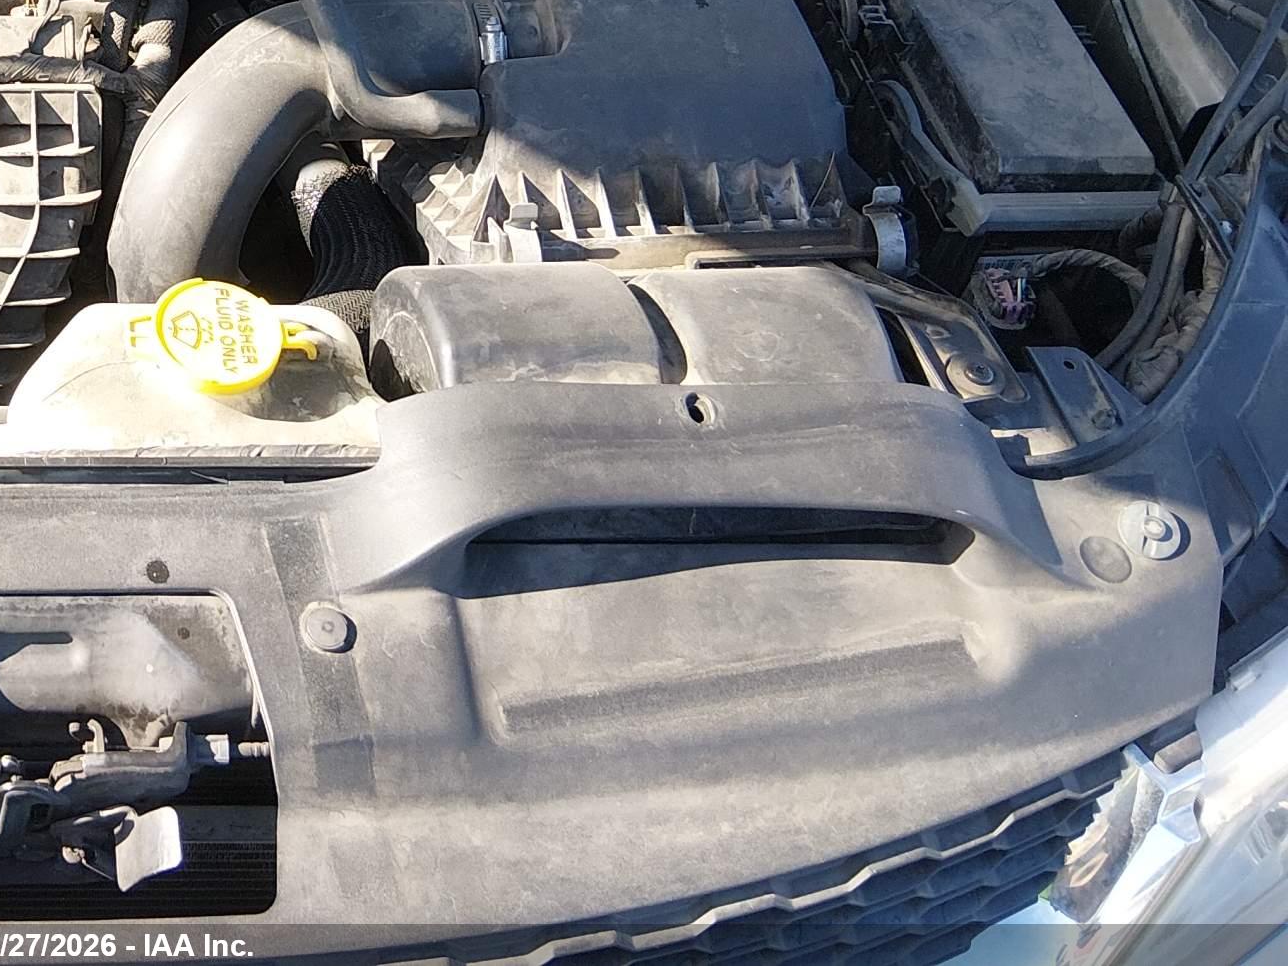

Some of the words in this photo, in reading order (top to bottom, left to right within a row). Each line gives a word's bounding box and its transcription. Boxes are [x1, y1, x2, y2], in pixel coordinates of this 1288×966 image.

[215, 288, 233, 332] FLUID
[236, 300, 258, 365] WASHER
[220, 337, 238, 373] ONLY
